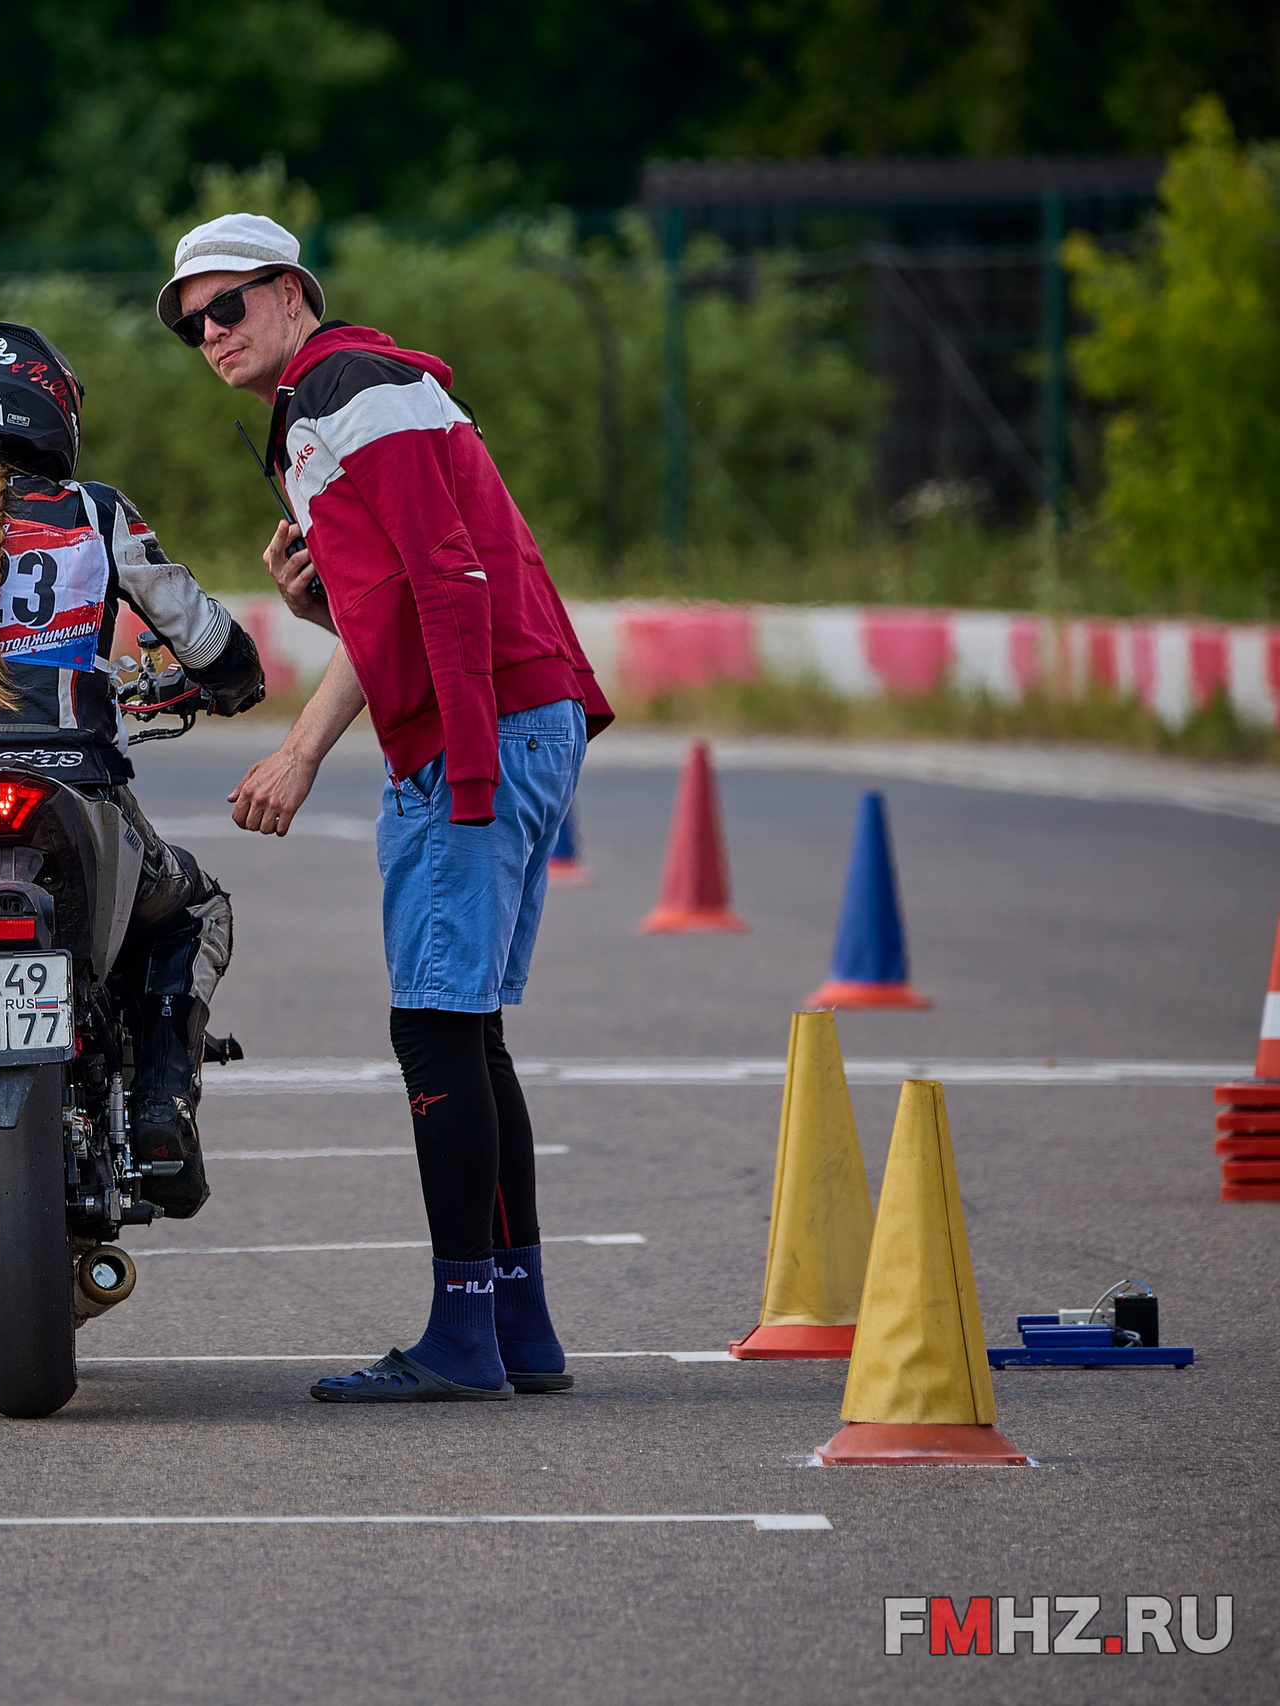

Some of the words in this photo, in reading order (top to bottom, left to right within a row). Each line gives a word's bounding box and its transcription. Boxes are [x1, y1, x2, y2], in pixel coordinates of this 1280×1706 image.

[0, 621, 97, 652] ОТОДЖИМХАНЫ
[5, 998, 35, 1010] RUS
[18, 1012, 60, 1044] 77
[493, 1266, 528, 1279] ILA
[446, 1280, 494, 1293] FILA
